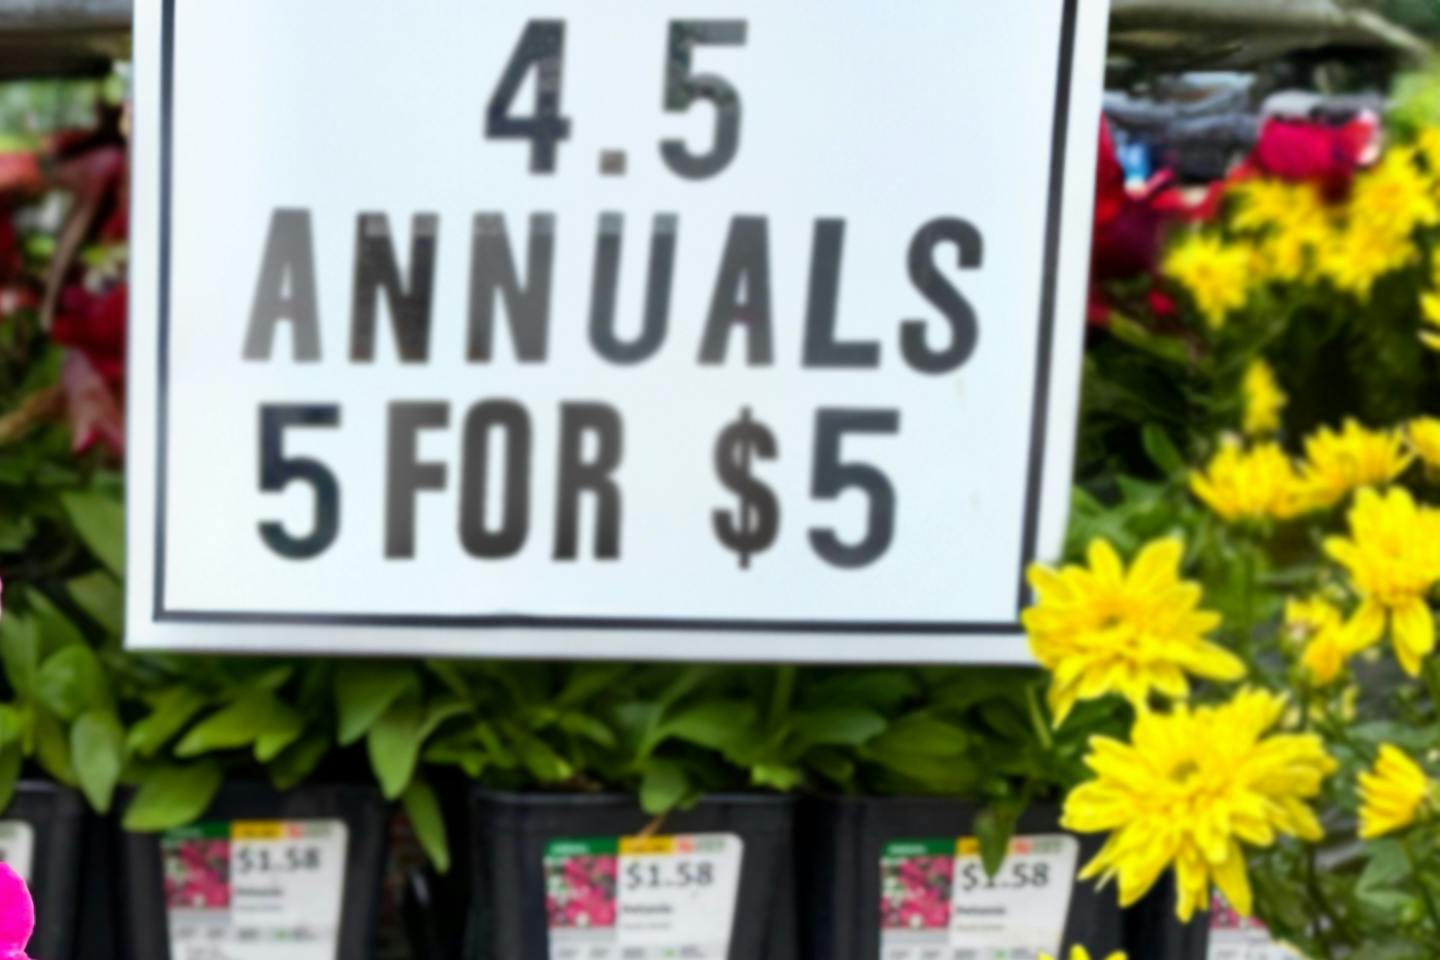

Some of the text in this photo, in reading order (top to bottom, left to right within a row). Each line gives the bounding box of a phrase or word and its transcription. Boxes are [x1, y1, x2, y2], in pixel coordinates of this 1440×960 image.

[483, 18, 749, 180] 4.5
[241, 207, 985, 374] ANNUALS
[257, 397, 901, 570] 5 FOR $5
[626, 861, 714, 891] $1.58
[962, 861, 1049, 891] $.58
